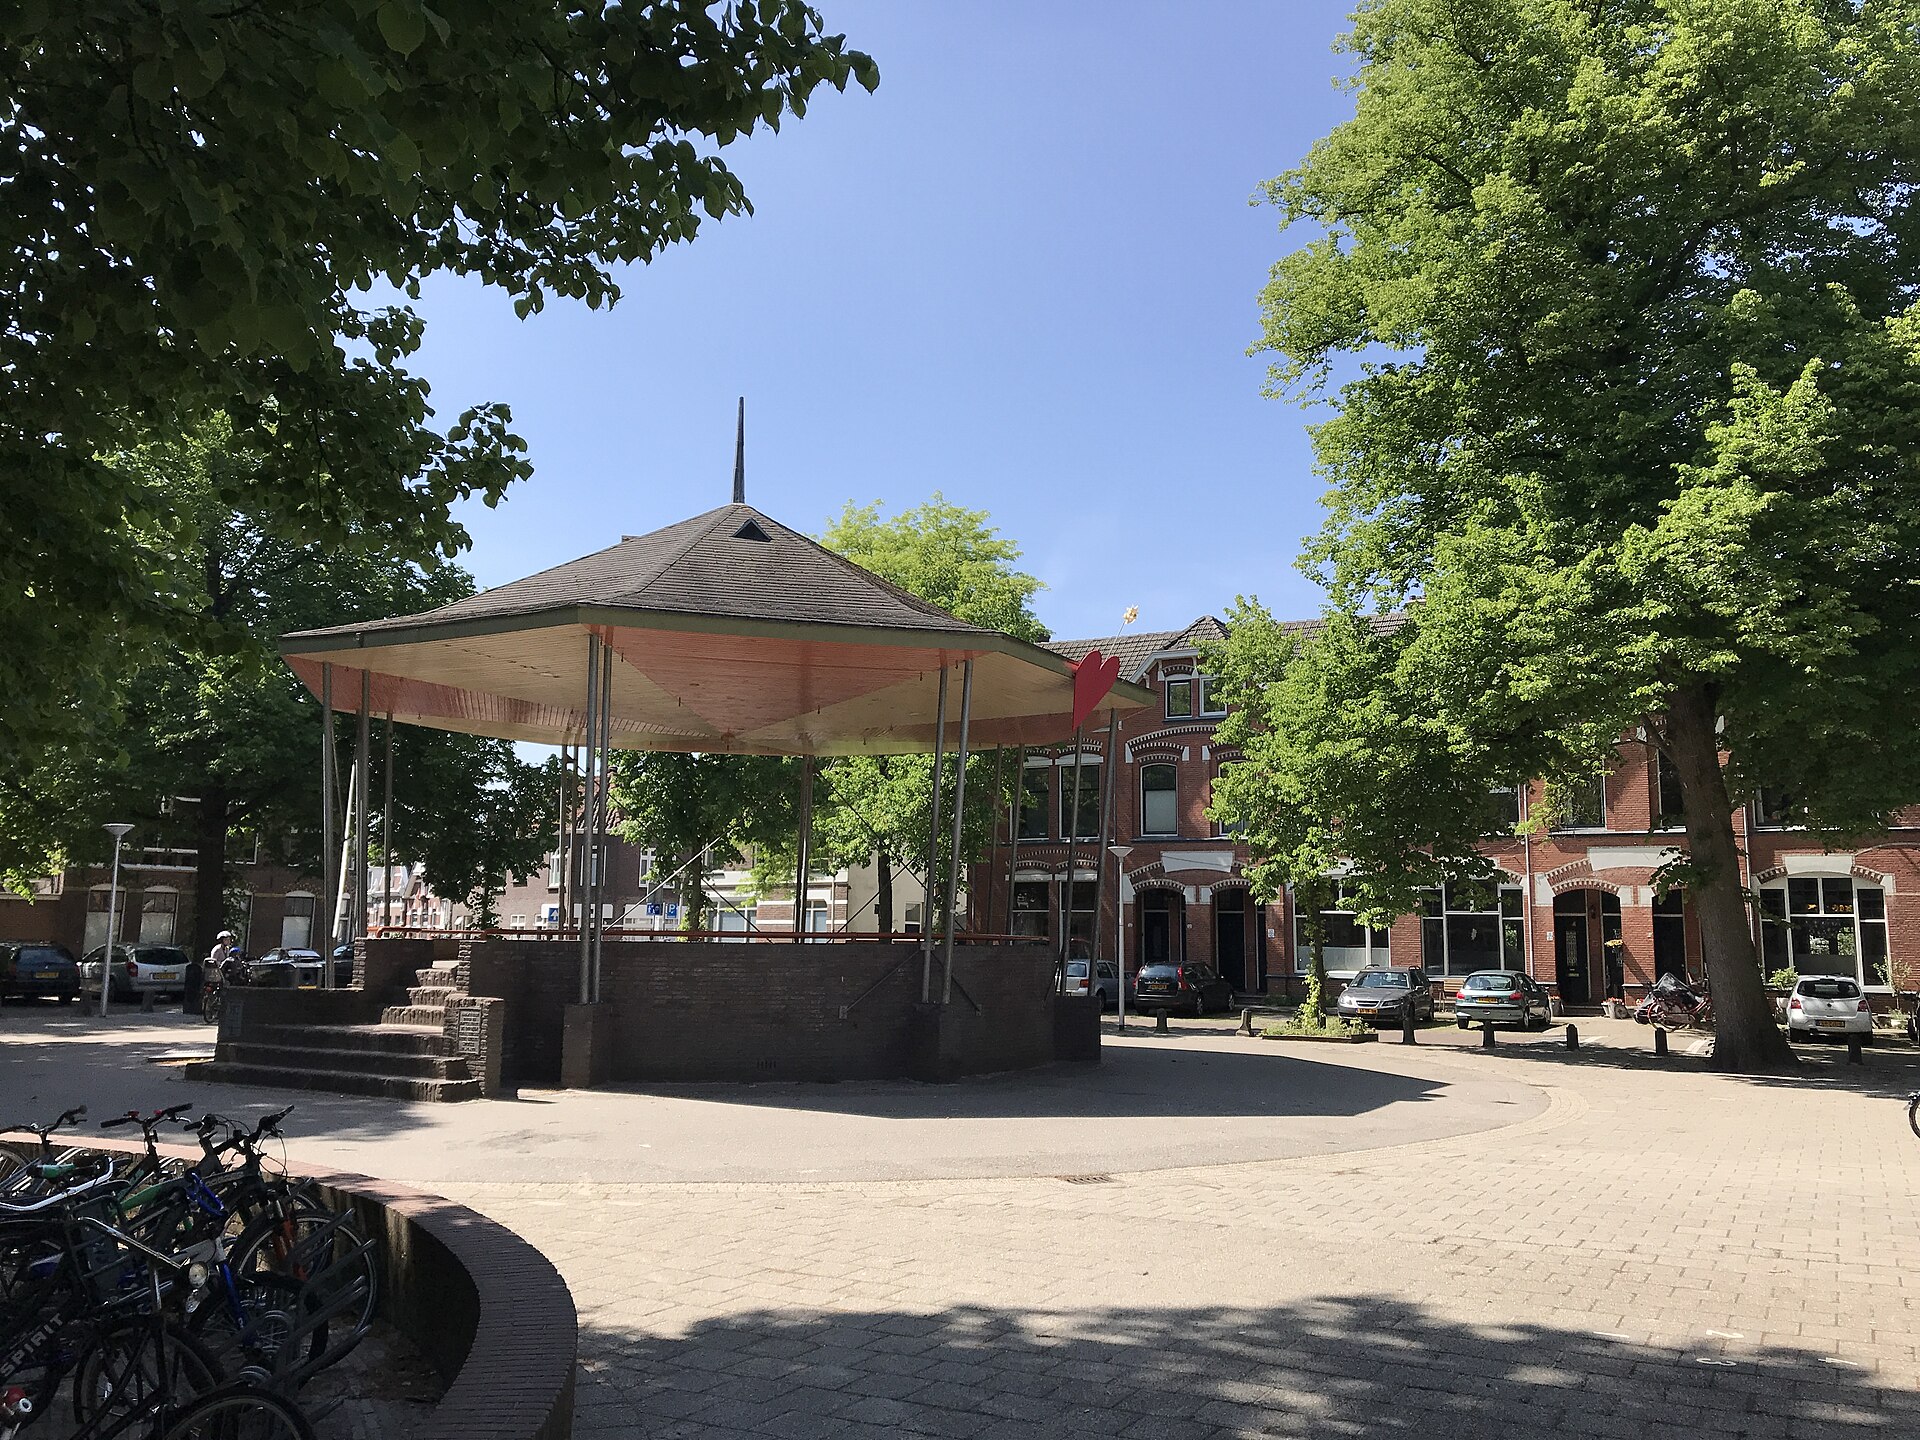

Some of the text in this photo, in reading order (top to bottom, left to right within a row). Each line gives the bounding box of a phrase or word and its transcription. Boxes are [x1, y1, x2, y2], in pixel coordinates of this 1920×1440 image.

[1705, 1328, 1745, 1339] 2
[0, 1312, 63, 1377] SPIRIT
[1696, 1357, 1737, 1367] 3
